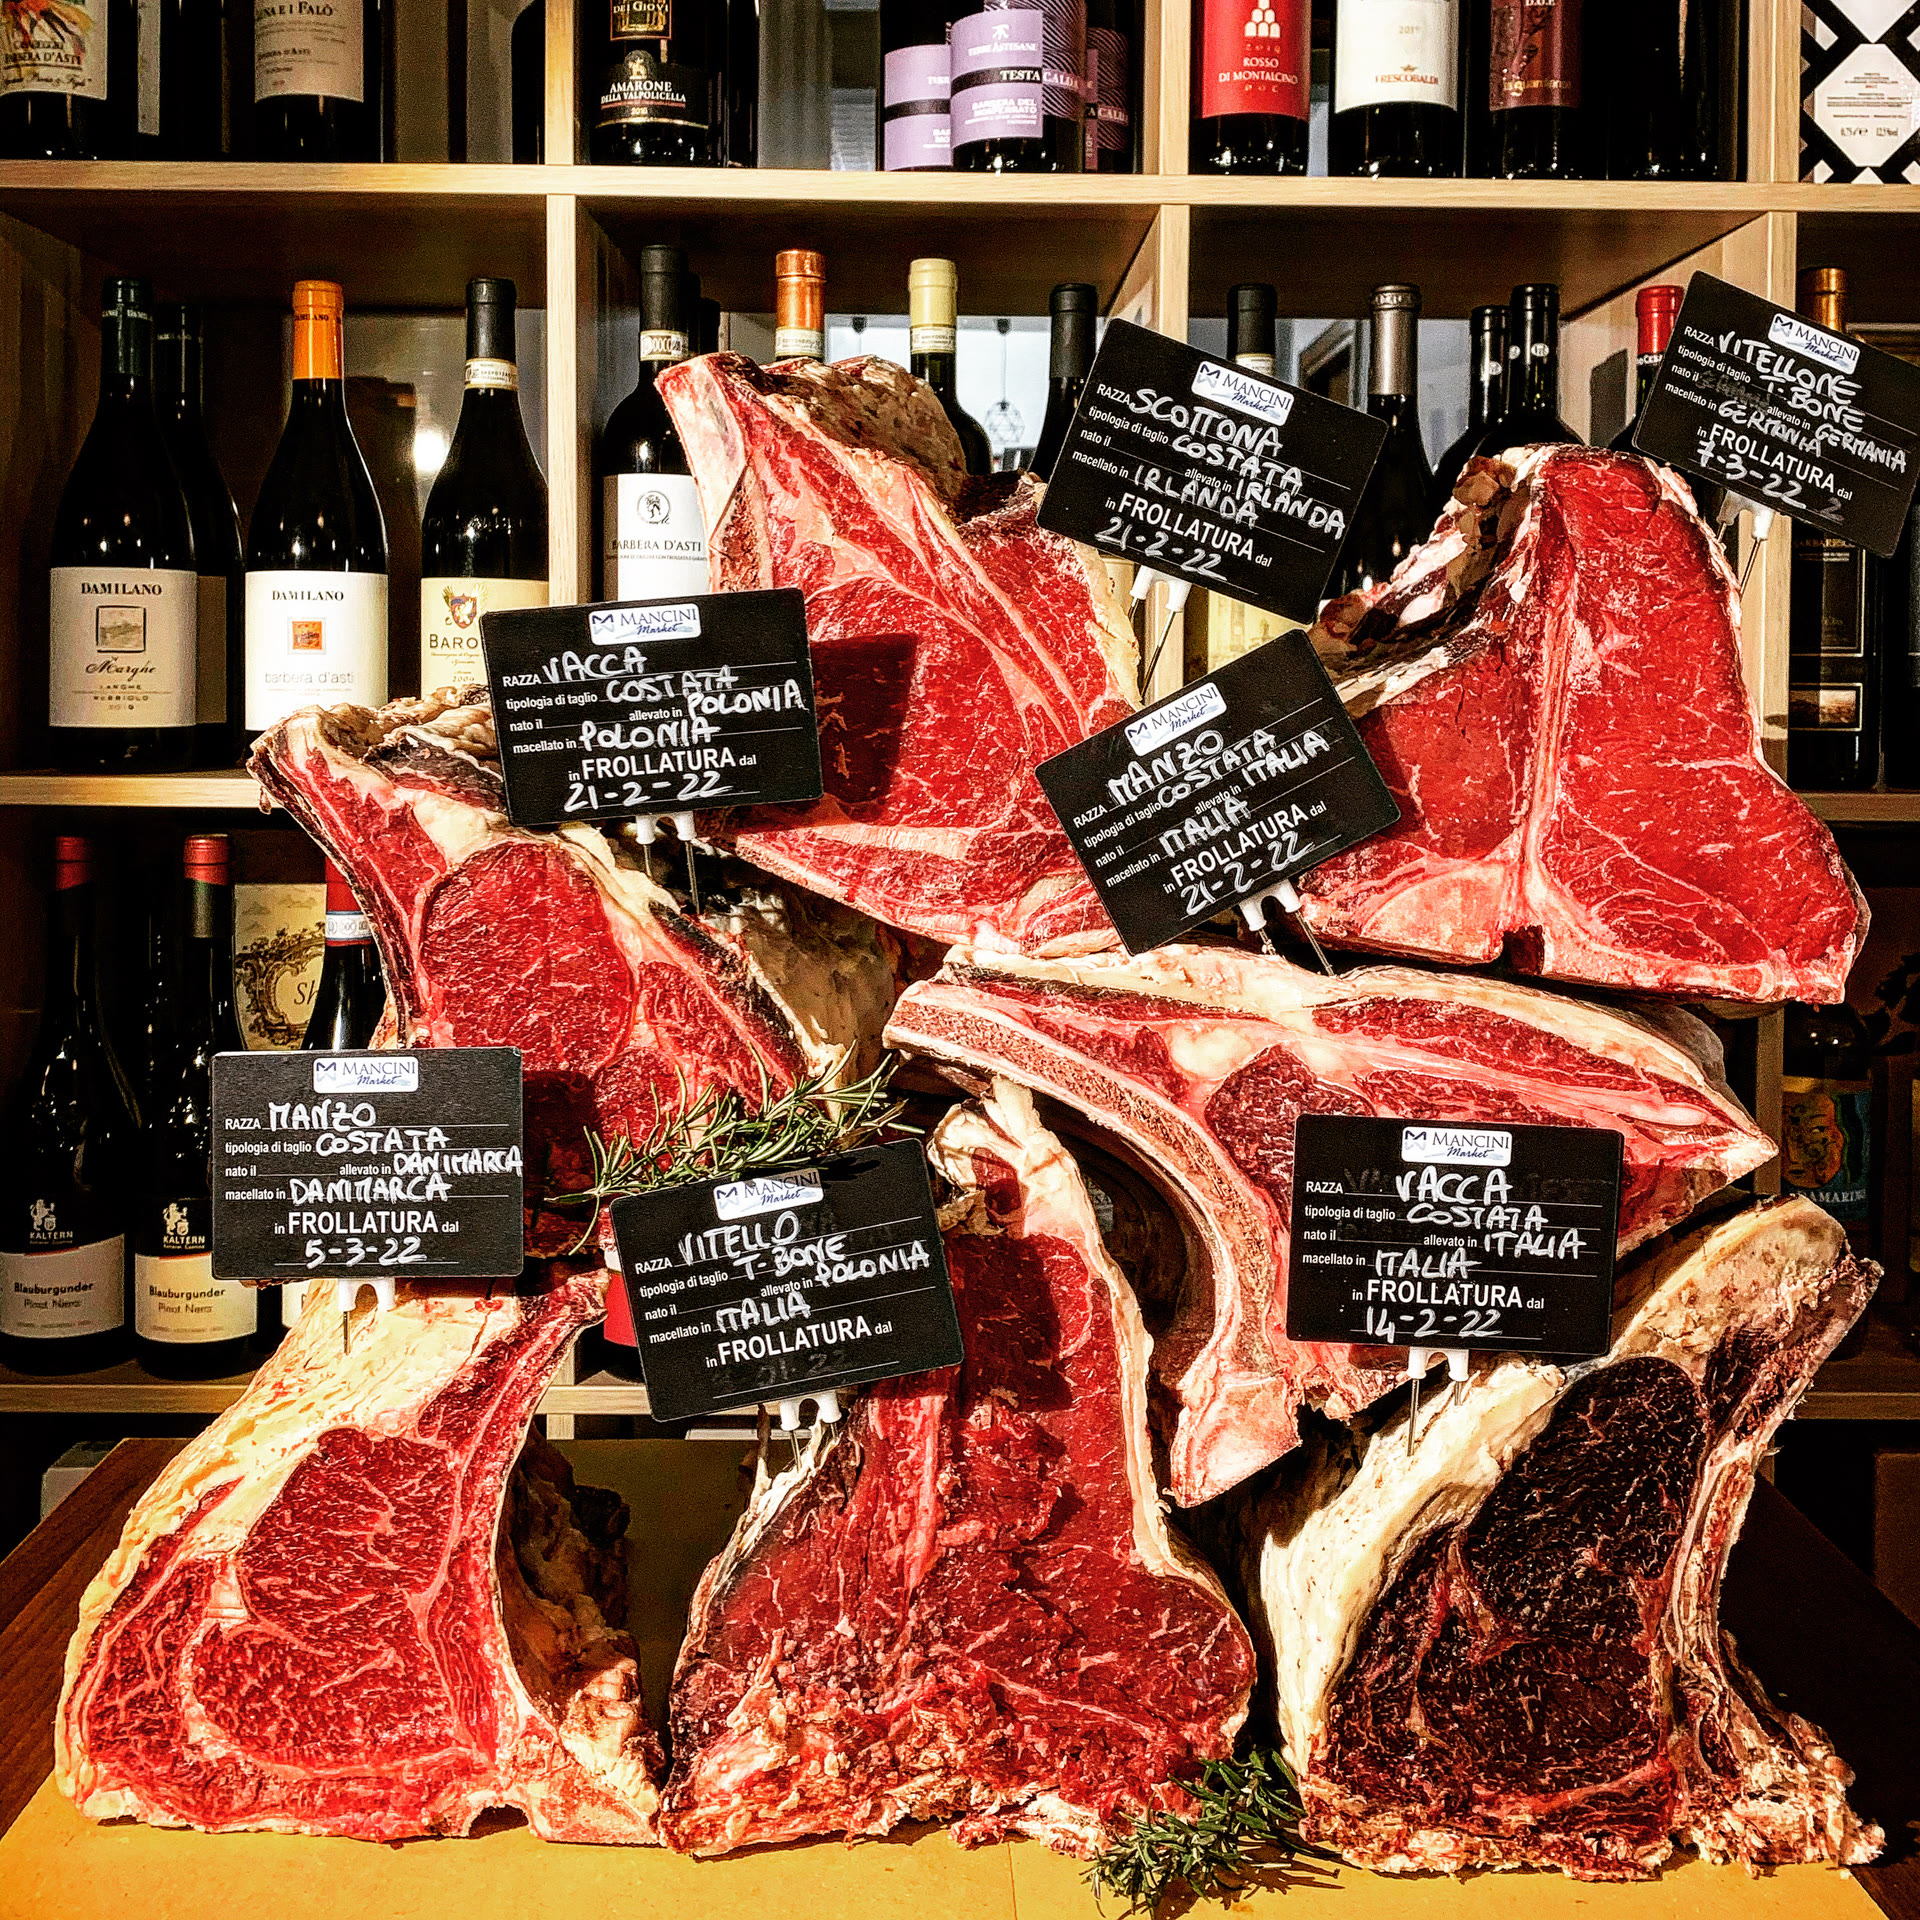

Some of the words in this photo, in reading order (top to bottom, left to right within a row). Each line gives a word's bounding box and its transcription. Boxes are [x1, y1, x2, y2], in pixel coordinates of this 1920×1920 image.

[298, 1, 334, 17] FALÒ
[612, 5, 631, 14] DEI
[632, 1, 670, 13] GIOVI
[1000, 69, 1041, 81] TESTA
[1218, 72, 1231, 83] DI
[1232, 70, 1299, 85] MONTALCINO
[1242, 56, 1280, 69] ROSSO
[600, 93, 622, 105] DELLA
[622, 91, 687, 103] VALPOLICELLA
[610, 80, 673, 94] AMARONE
[1795, 325, 1858, 362] MANCINI
[1804, 341, 1844, 362] Market
[1677, 345, 1716, 368] tipologia
[1726, 365, 1751, 384] taglio
[1684, 325, 1715, 347] RAZZA
[1719, 330, 1863, 404] VITELLONE
[1222, 374, 1291, 411] MANCINI
[1232, 389, 1275, 413] Market
[1096, 383, 1132, 407] RAZZA
[1129, 388, 1283, 457] SCOTTONA
[1664, 382, 1707, 408] macellato
[1718, 400, 1822, 458] GERMANIA
[1671, 364, 1692, 379] nato
[1766, 405, 1801, 427] allevato
[1815, 423, 1907, 474] GERMANIA
[1088, 405, 1130, 431] tipologia
[1142, 426, 1169, 446] taglio
[1172, 434, 1303, 496] COSTATA
[1709, 423, 1836, 494] FROLLATURA
[1836, 487, 1854, 501] dal
[1072, 450, 1119, 476] macellato
[1134, 464, 1259, 529] IRLANDA
[1080, 428, 1103, 444] nato
[1184, 467, 1222, 488] allevato
[1235, 478, 1346, 540] IRLANDA
[1697, 440, 1807, 510] 7-3-22
[663, 539, 702, 553] D'ASTI
[1118, 492, 1256, 561] FROLLATURA
[1255, 553, 1273, 568] dal
[1094, 516, 1227, 581] 21-2-22
[80, 582, 163, 597] DAMILANO
[271, 589, 346, 602] DAMILANO
[620, 607, 698, 627] MANCINI
[637, 622, 684, 636] Market
[429, 633, 479, 650] BARO
[85, 657, 158, 683] Marghe
[264, 671, 314, 685] barbera
[317, 671, 355, 685] d'asti
[502, 674, 542, 688] RAZZA
[542, 645, 648, 684] VACCA
[506, 694, 553, 711] tipologia
[567, 692, 598, 708] taglio
[606, 664, 739, 704] COSTATA
[509, 721, 534, 732] nato
[628, 709, 671, 722] allevato
[688, 679, 809, 720] POLONIA
[1151, 686, 1219, 730] MANCINI
[1170, 703, 1208, 732] Market
[512, 740, 565, 755] macellato
[579, 715, 722, 752] POLONIA
[581, 746, 736, 781] FROLLATURA
[738, 754, 758, 767] dal
[1073, 804, 1108, 829] RAZZA
[1107, 729, 1225, 806] MANZO
[563, 770, 734, 813] 21-2-22
[1083, 821, 1125, 849] tipologia
[1134, 802, 1162, 824] taglio
[1158, 729, 1276, 809] COSTATA
[1095, 851, 1117, 869] nato
[1193, 790, 1231, 816] allevato
[1242, 730, 1330, 786] ITALIA
[1105, 857, 1149, 888] macellato
[1159, 796, 1252, 858] ITALIA
[1170, 803, 1310, 888] FROLLATURA
[1309, 800, 1327, 818] dal
[1180, 831, 1316, 916] 21-2-22
[342, 1061, 416, 1076] MANCINI
[356, 1074, 402, 1087] Market
[224, 1117, 262, 1130] RAZZA
[268, 1098, 377, 1132] MANZO
[224, 1141, 269, 1156] tipologia
[283, 1140, 313, 1156] taglio
[315, 1127, 452, 1157] COSTATA
[1432, 1131, 1510, 1150] MANCINI
[1447, 1145, 1494, 1159] Market
[224, 1166, 248, 1178] nato
[339, 1163, 379, 1176] allevato
[393, 1145, 524, 1176] DANIMARCA
[224, 1189, 274, 1201] macellato
[744, 1171, 819, 1199] MANCINI
[761, 1187, 806, 1206] Market
[1305, 1180, 1344, 1194] RAZZA
[1395, 1165, 1513, 1206] VACCA
[287, 1210, 439, 1235] FROLLATURA
[441, 1220, 460, 1234] dal
[1304, 1204, 1351, 1220] tipologia
[1365, 1207, 1396, 1223] taglio
[1406, 1202, 1549, 1231] COSTATA
[29, 1230, 74, 1240] KALTERN
[162, 1235, 206, 1245] KALTERN
[635, 1256, 673, 1275] RAZZA
[678, 1210, 801, 1267] VITELLO
[1303, 1229, 1328, 1241] nato
[1423, 1234, 1466, 1247] allevato
[1484, 1228, 1588, 1260] ITALIA
[304, 1235, 428, 1270] 5-3-22
[639, 1280, 686, 1300] tipologia
[698, 1269, 729, 1288] taglio
[732, 1234, 848, 1281] T-BONE
[1302, 1252, 1354, 1266] macellato
[1375, 1247, 1483, 1280] ITALIA
[13, 1280, 95, 1297] Blauburgunder
[149, 1285, 227, 1301] Blauburgunder
[644, 1306, 669, 1322] nato
[759, 1280, 801, 1298] allevato
[815, 1240, 930, 1288] POLONIA
[1367, 1278, 1523, 1309] FROLLATURA
[1526, 1297, 1545, 1310] dal
[649, 1325, 700, 1345] macellato
[715, 1290, 812, 1334] ITALIA
[1366, 1305, 1503, 1344] 14-2-22
[717, 1314, 873, 1366] FROLLATURA
[873, 1320, 893, 1336] dal
